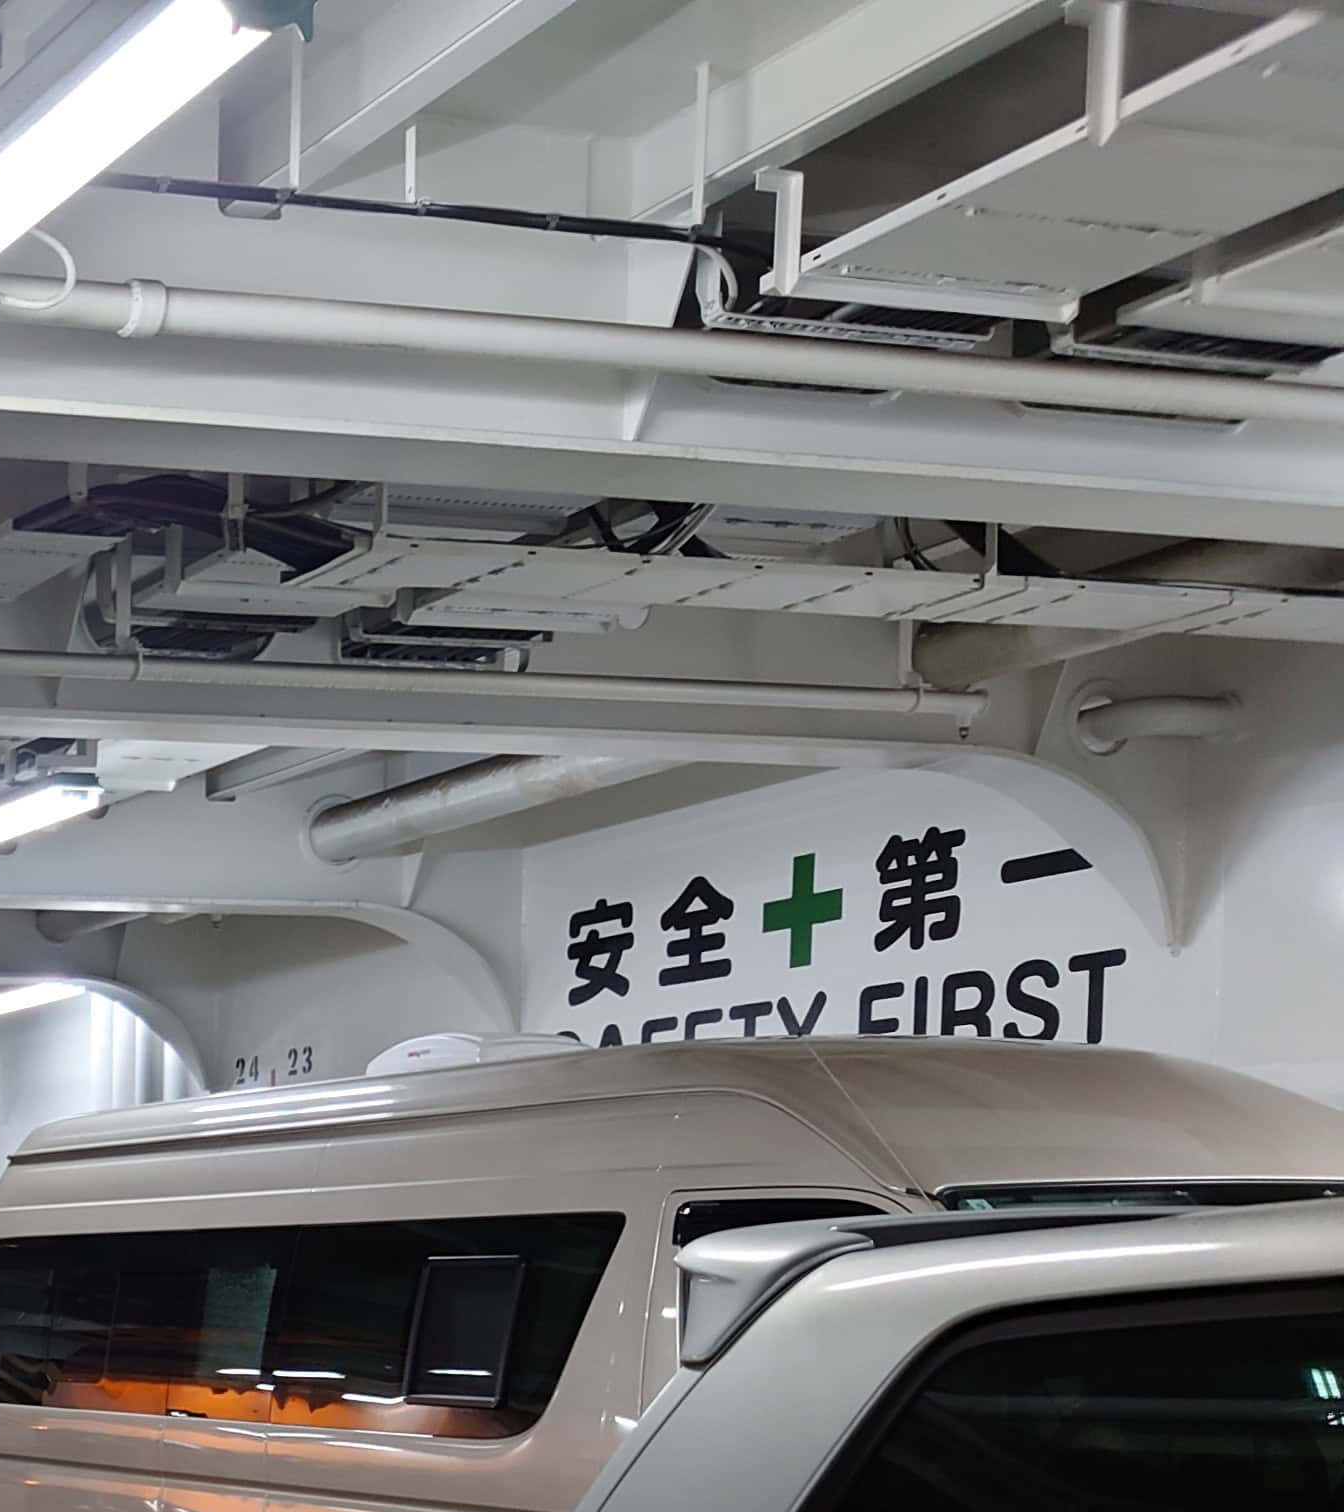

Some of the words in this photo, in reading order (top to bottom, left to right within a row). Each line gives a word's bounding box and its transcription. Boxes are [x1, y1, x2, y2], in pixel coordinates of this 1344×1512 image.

[567, 875, 734, 1005] 安全
[873, 826, 1094, 952] 第一
[859, 948, 1126, 1044] FIRST
[236, 1056, 259, 1084] 24
[288, 1046, 312, 1076] 23
